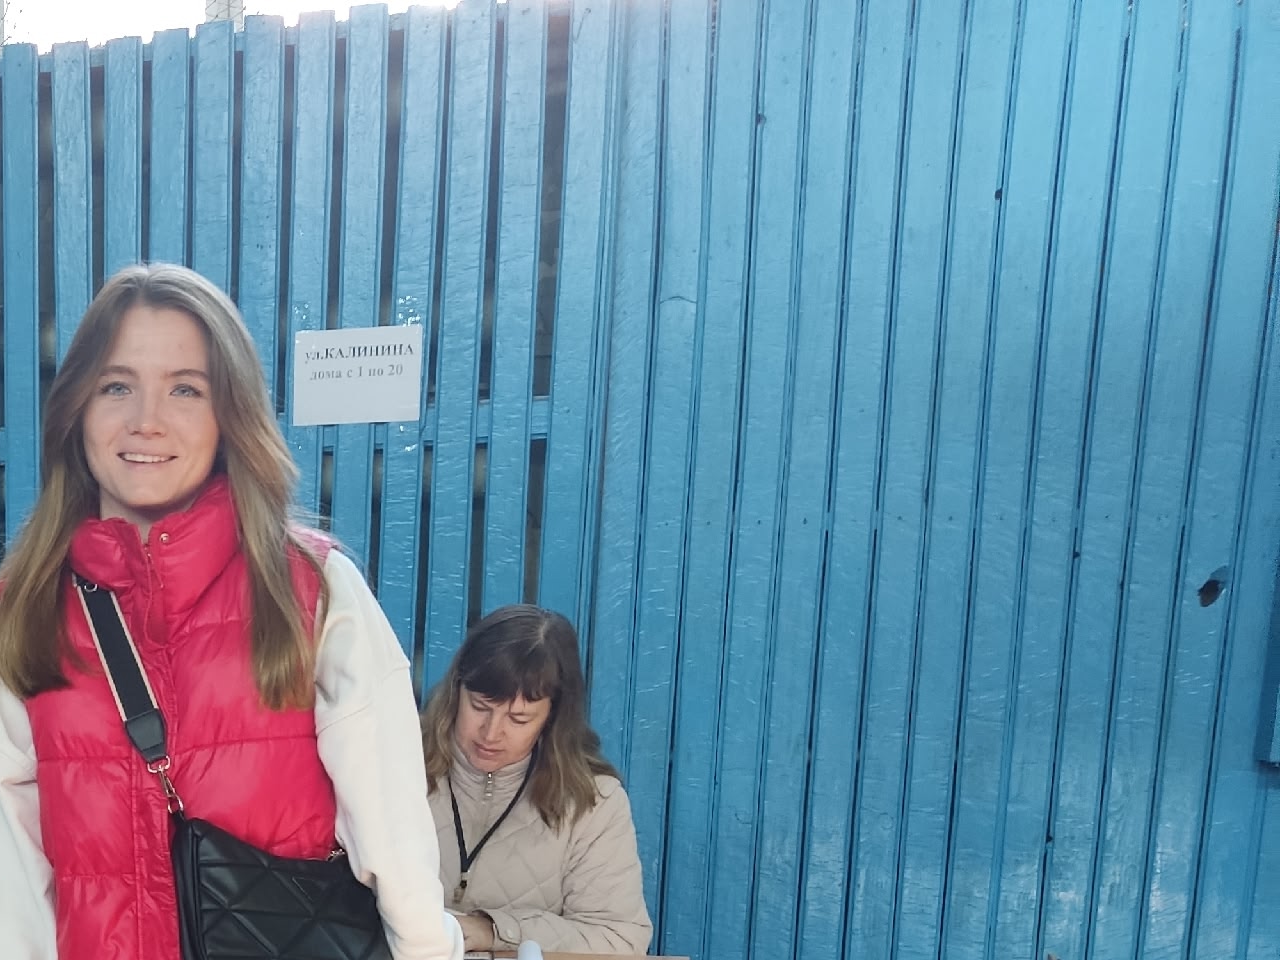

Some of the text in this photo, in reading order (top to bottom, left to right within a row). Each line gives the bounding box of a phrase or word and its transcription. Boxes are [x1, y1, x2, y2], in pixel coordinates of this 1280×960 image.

[305, 344, 414, 364] ул.КАЛИНИНА
[309, 364, 404, 381] дома с 1 по 20
